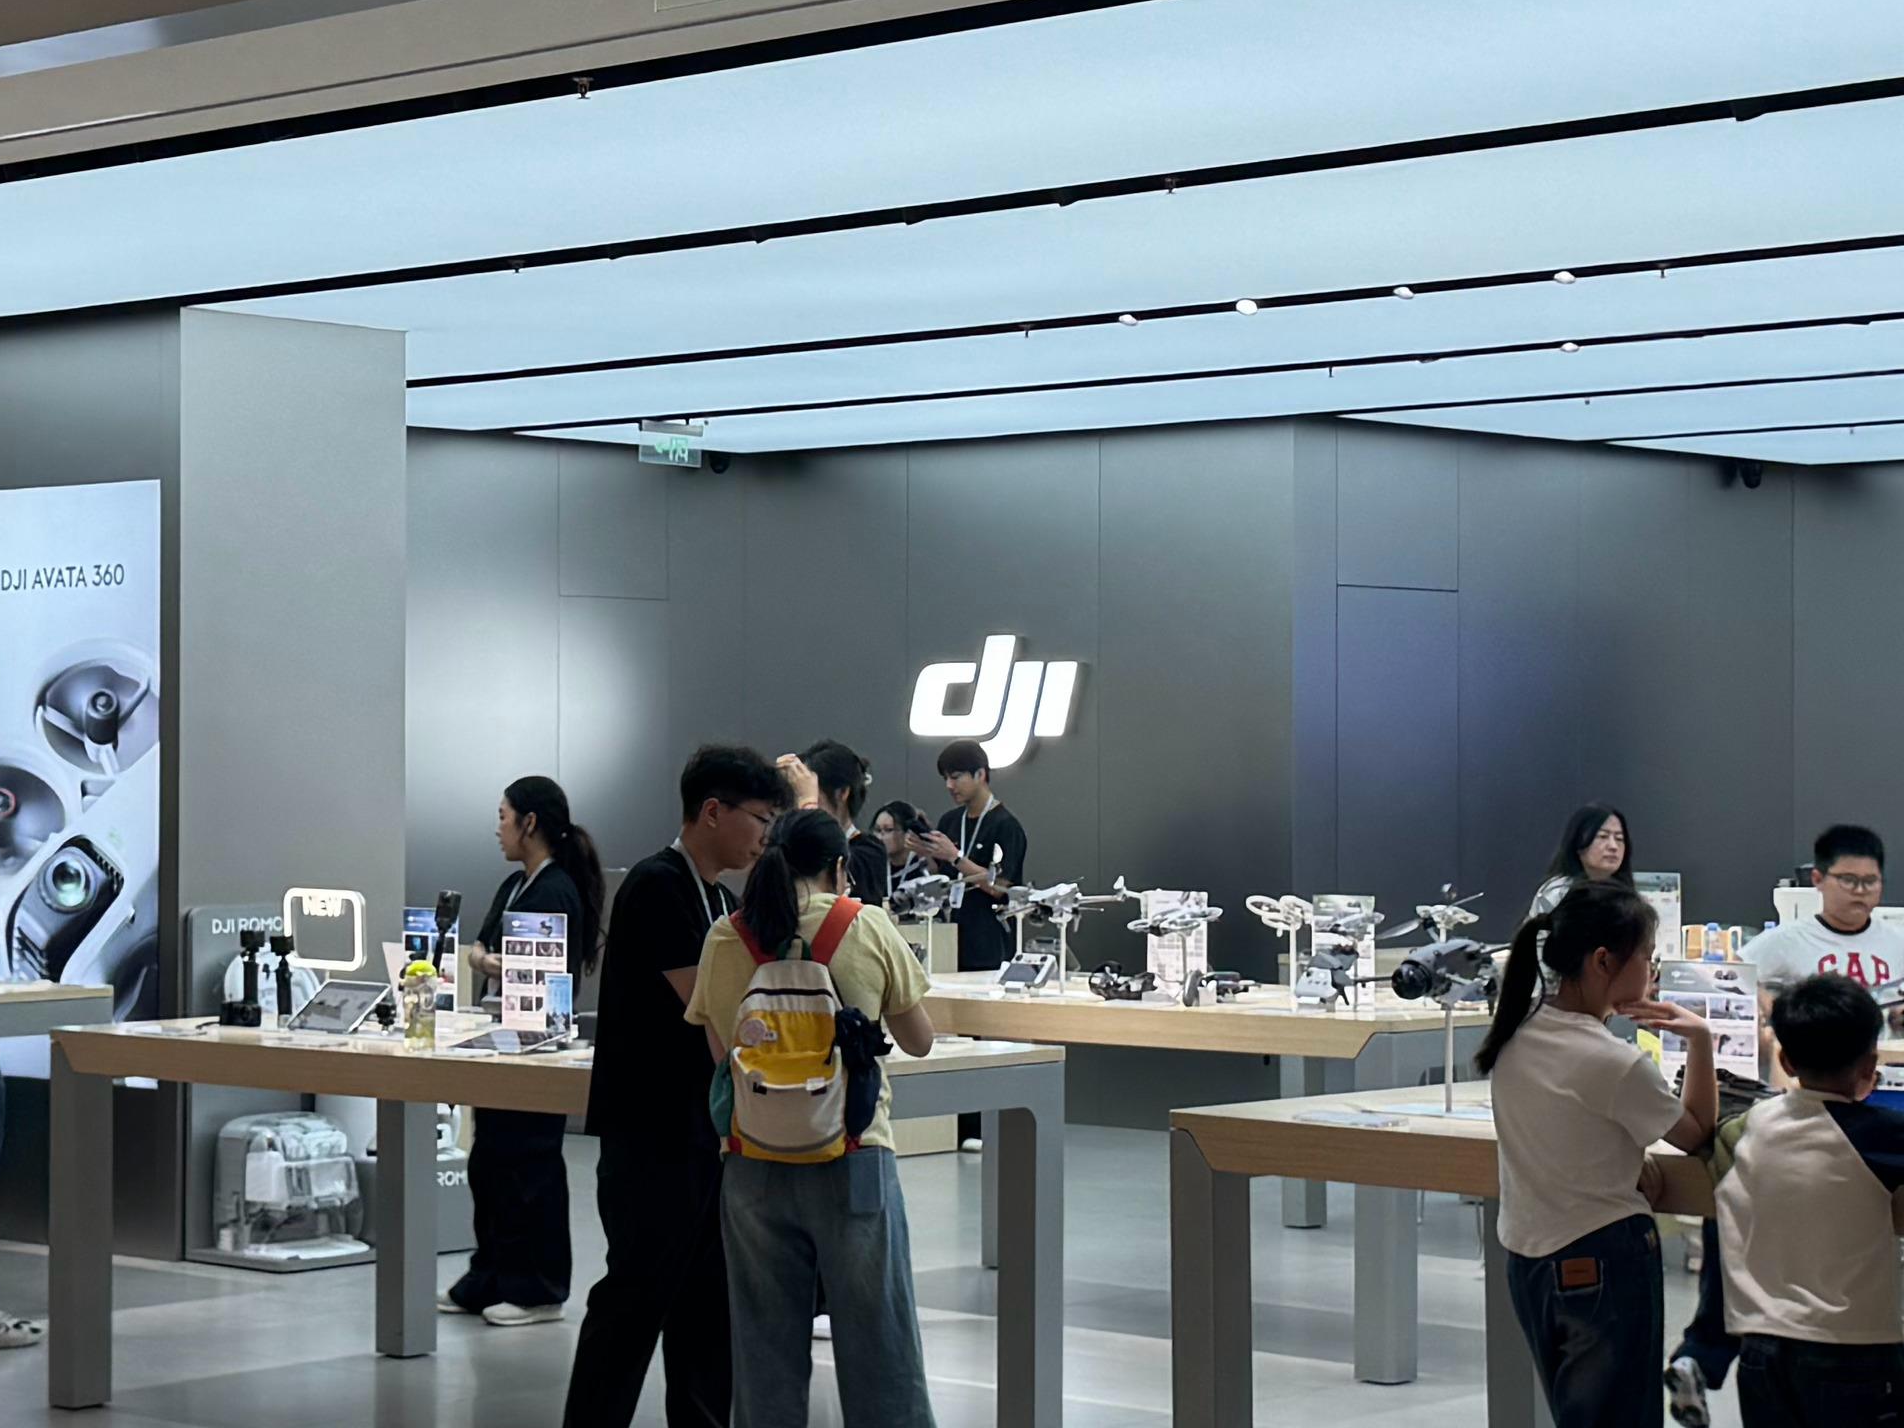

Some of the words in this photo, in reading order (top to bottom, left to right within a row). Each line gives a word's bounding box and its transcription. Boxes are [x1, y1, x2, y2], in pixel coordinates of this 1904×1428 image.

[1, 569, 27, 591] DJI
[32, 566, 88, 589] AVATA
[92, 564, 125, 586] 360
[302, 895, 343, 918] NEW
[211, 918, 236, 934] DJI
[238, 916, 283, 932] ROMO
